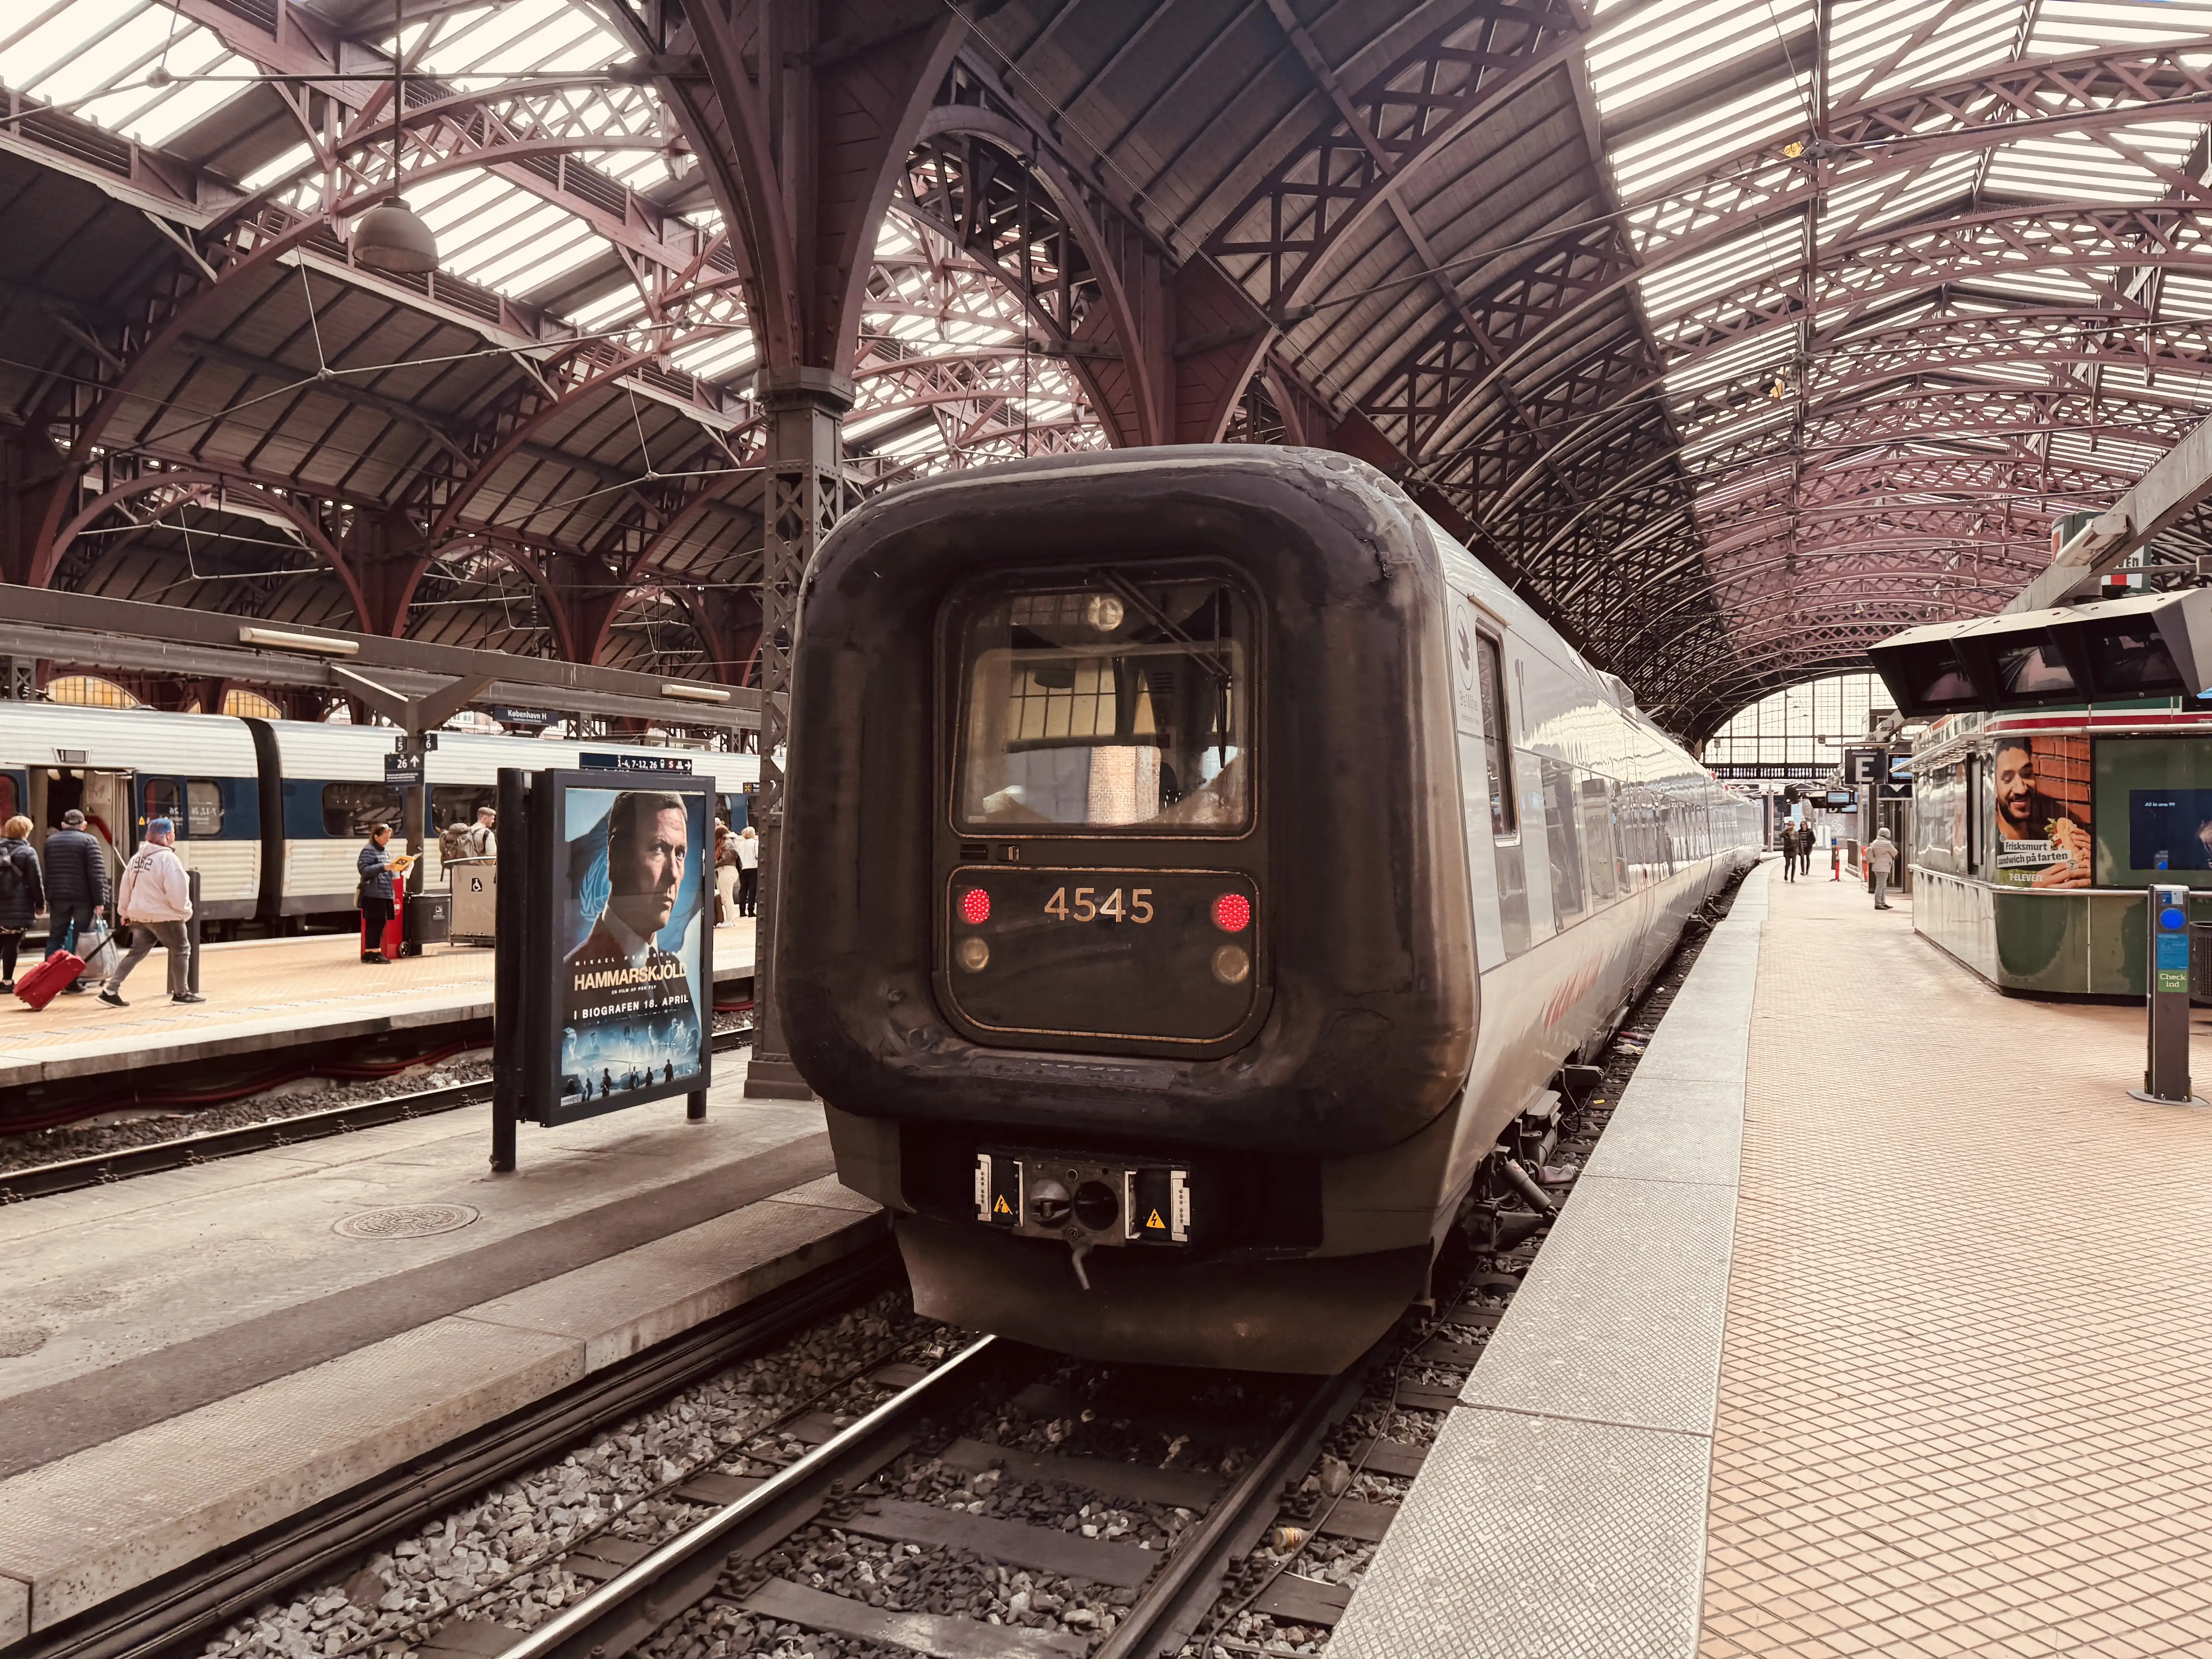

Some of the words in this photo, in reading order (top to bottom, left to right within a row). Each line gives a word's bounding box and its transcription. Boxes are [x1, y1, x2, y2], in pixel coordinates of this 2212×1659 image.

[398, 741, 403, 751] 5
[426, 739, 431, 749] 6
[397, 759, 408, 769] 26
[649, 761, 657, 769] 26
[1855, 757, 1874, 782] E
[2006, 842, 2047, 851] Frisksmurt
[2026, 852, 2037, 864] på
[2038, 852, 2068, 861] farten
[1044, 887, 1154, 924] 4545
[575, 957, 615, 966] MIKAEL
[574, 960, 688, 991] HAMMARSKJÖLD
[574, 1010, 577, 1020] I
[582, 1001, 640, 1019] BIOGRAFEN
[644, 999, 658, 1009] 18.
[661, 994, 689, 1007] APRIL
